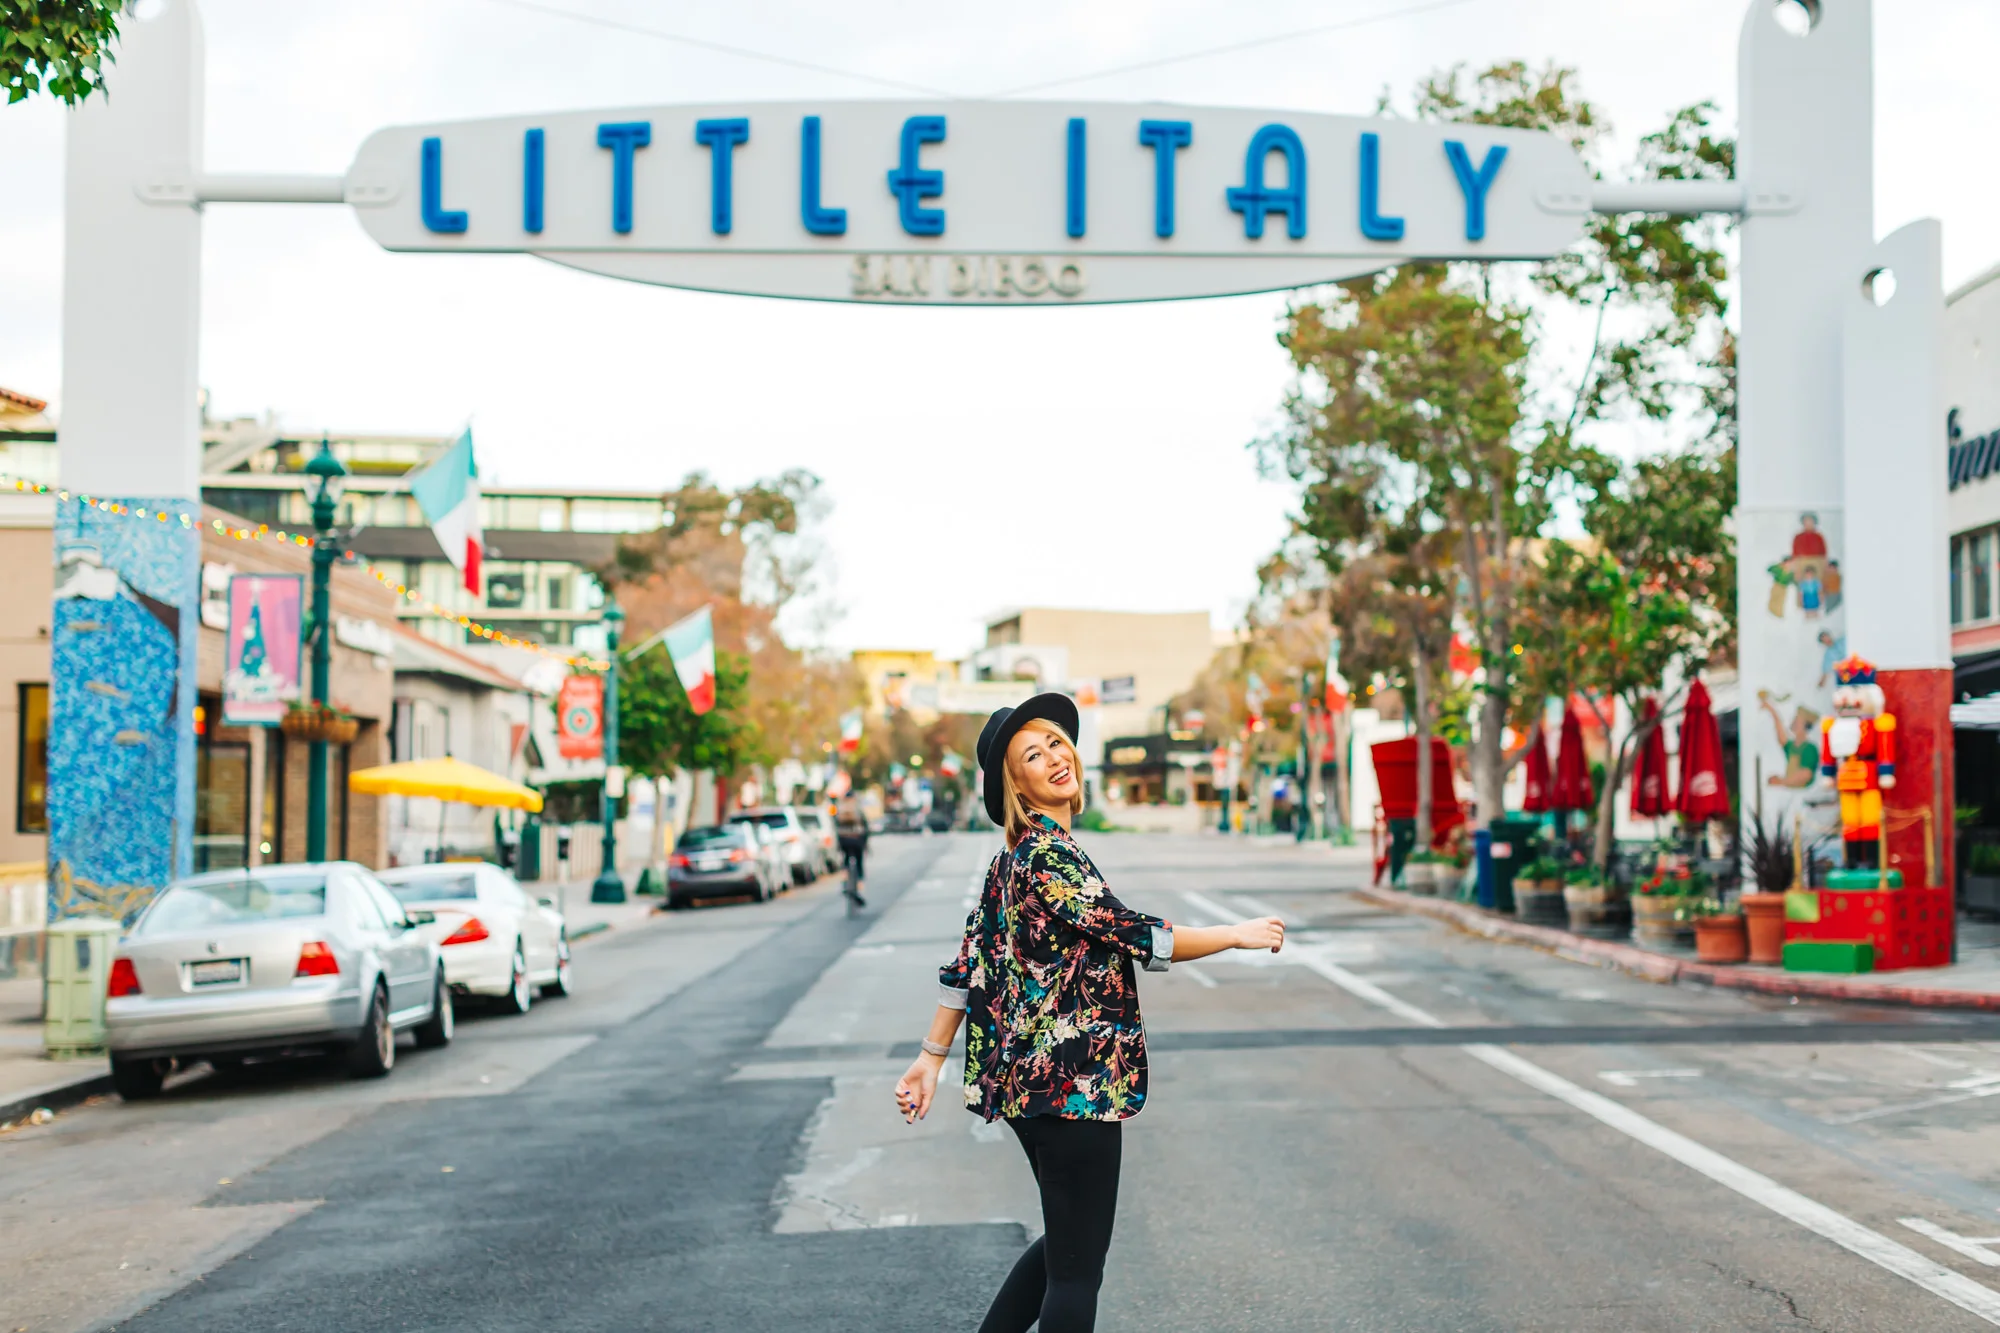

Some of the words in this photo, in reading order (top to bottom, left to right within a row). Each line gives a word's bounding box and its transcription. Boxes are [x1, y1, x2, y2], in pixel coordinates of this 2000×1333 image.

[420, 115, 946, 236] LITTLE
[1066, 117, 1509, 241] ITALY
[851, 254, 932, 297] SAN
[949, 254, 1086, 298] DIEGO
